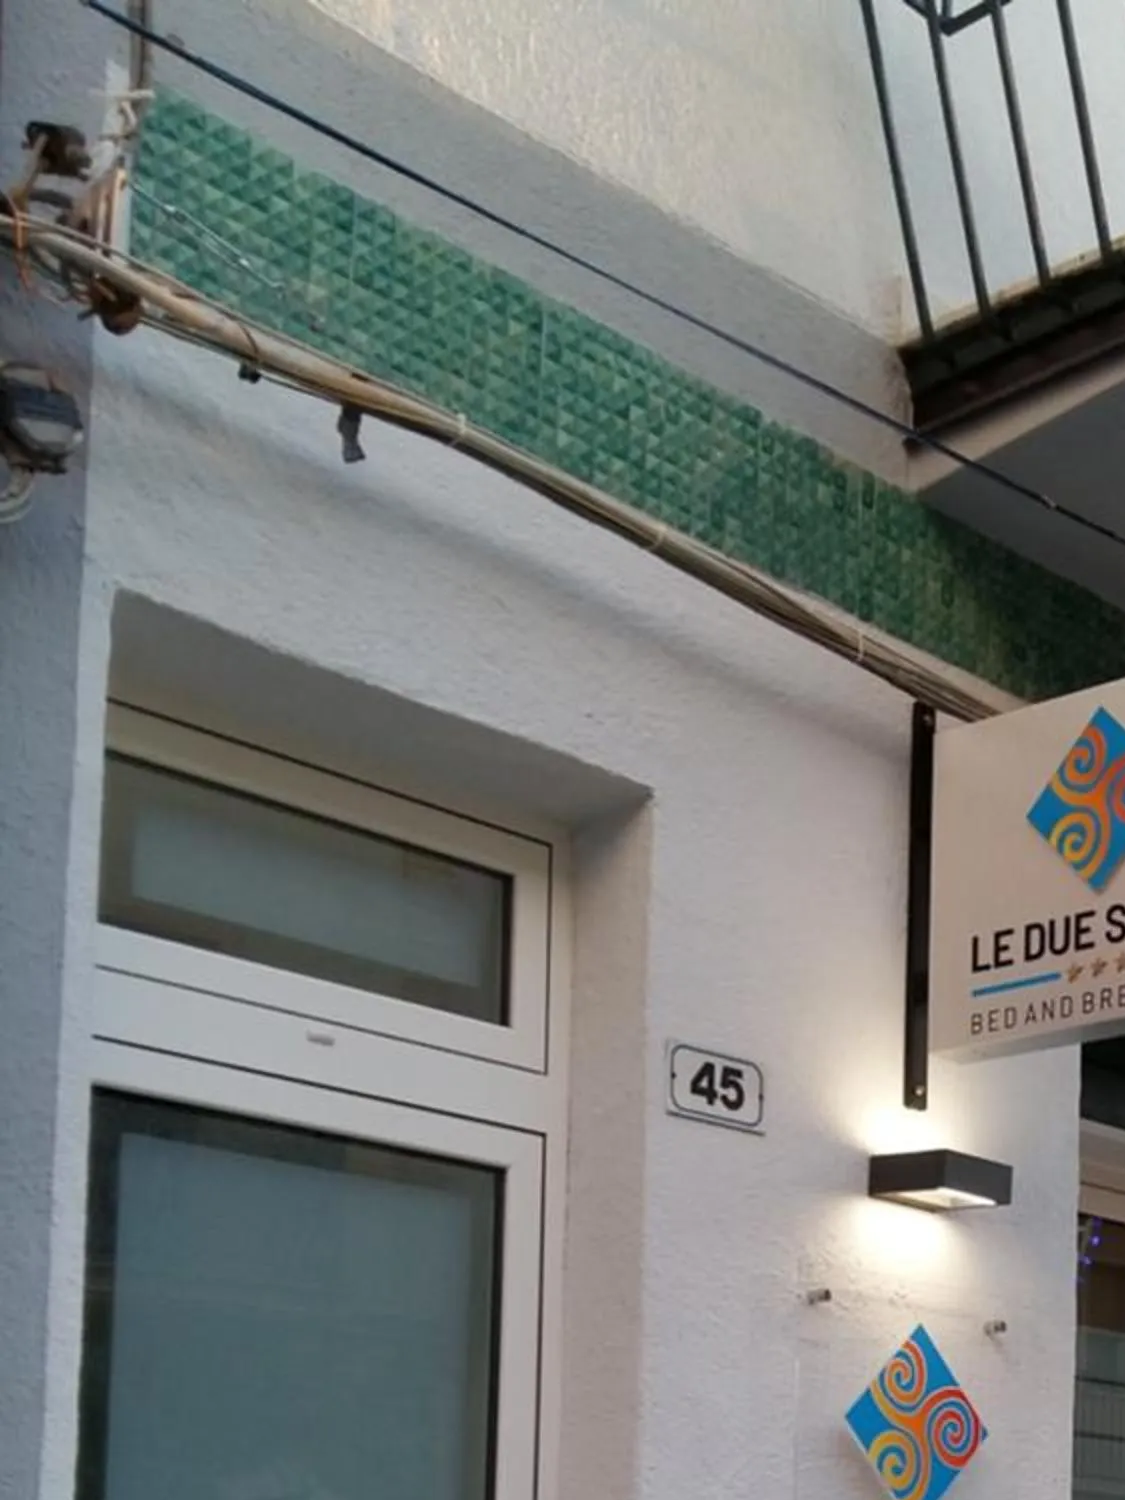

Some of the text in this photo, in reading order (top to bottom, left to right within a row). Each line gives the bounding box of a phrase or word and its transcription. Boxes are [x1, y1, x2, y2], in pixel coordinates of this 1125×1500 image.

[970, 928, 1015, 974] LE
[1023, 910, 1096, 963] DUE
[970, 1004, 1016, 1036] BED
[1024, 991, 1074, 1025] AND
[689, 1061, 745, 1111] 45
